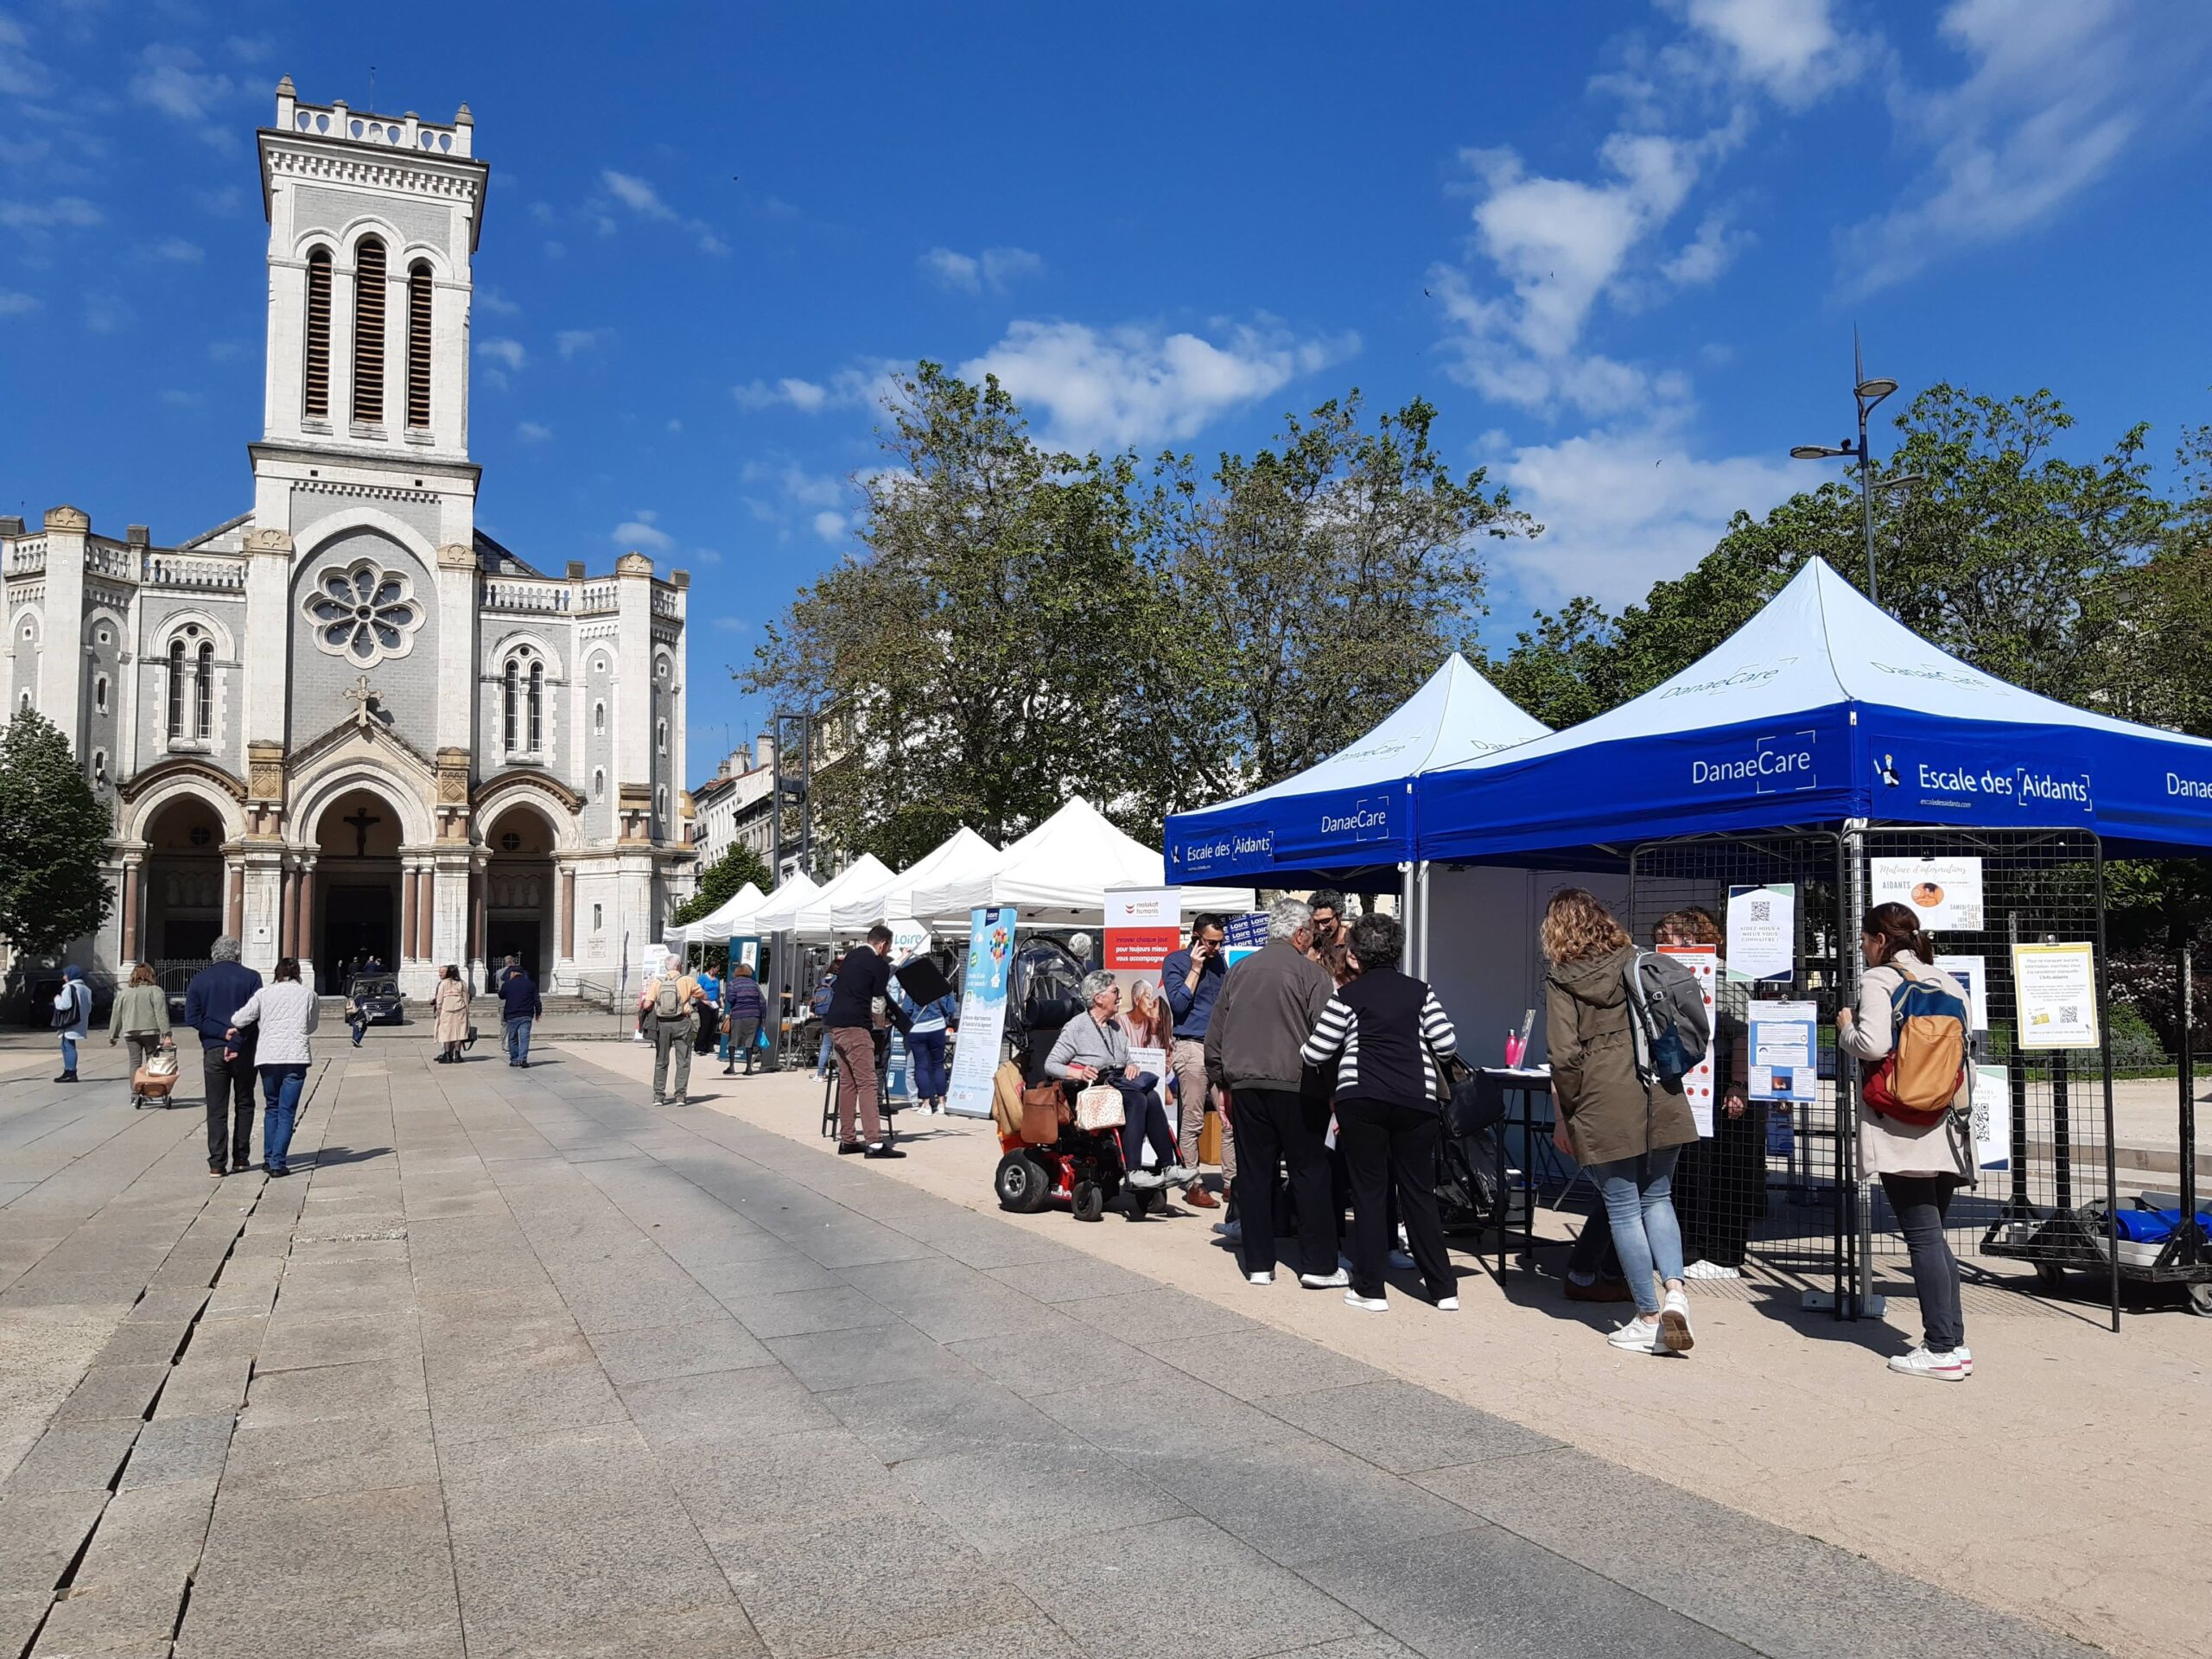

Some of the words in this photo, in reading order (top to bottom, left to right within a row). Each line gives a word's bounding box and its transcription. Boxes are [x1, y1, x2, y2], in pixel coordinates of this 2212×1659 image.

[1659, 670, 1779, 699] DanaeCare
[1693, 751, 1810, 784] DanaeCare
[1919, 764, 1978, 791] Escale
[1981, 770, 2012, 795] des
[2023, 774, 2088, 802] Aidants
[1321, 810, 1386, 833] DanaeCare
[1187, 843, 1214, 861] Escale
[1215, 842, 1230, 857] des
[1235, 836, 1271, 854] Aidants
[1967, 904, 1981, 912] SAVE
[1967, 912, 1978, 921] THE
[1967, 920, 1982, 929] DATE
